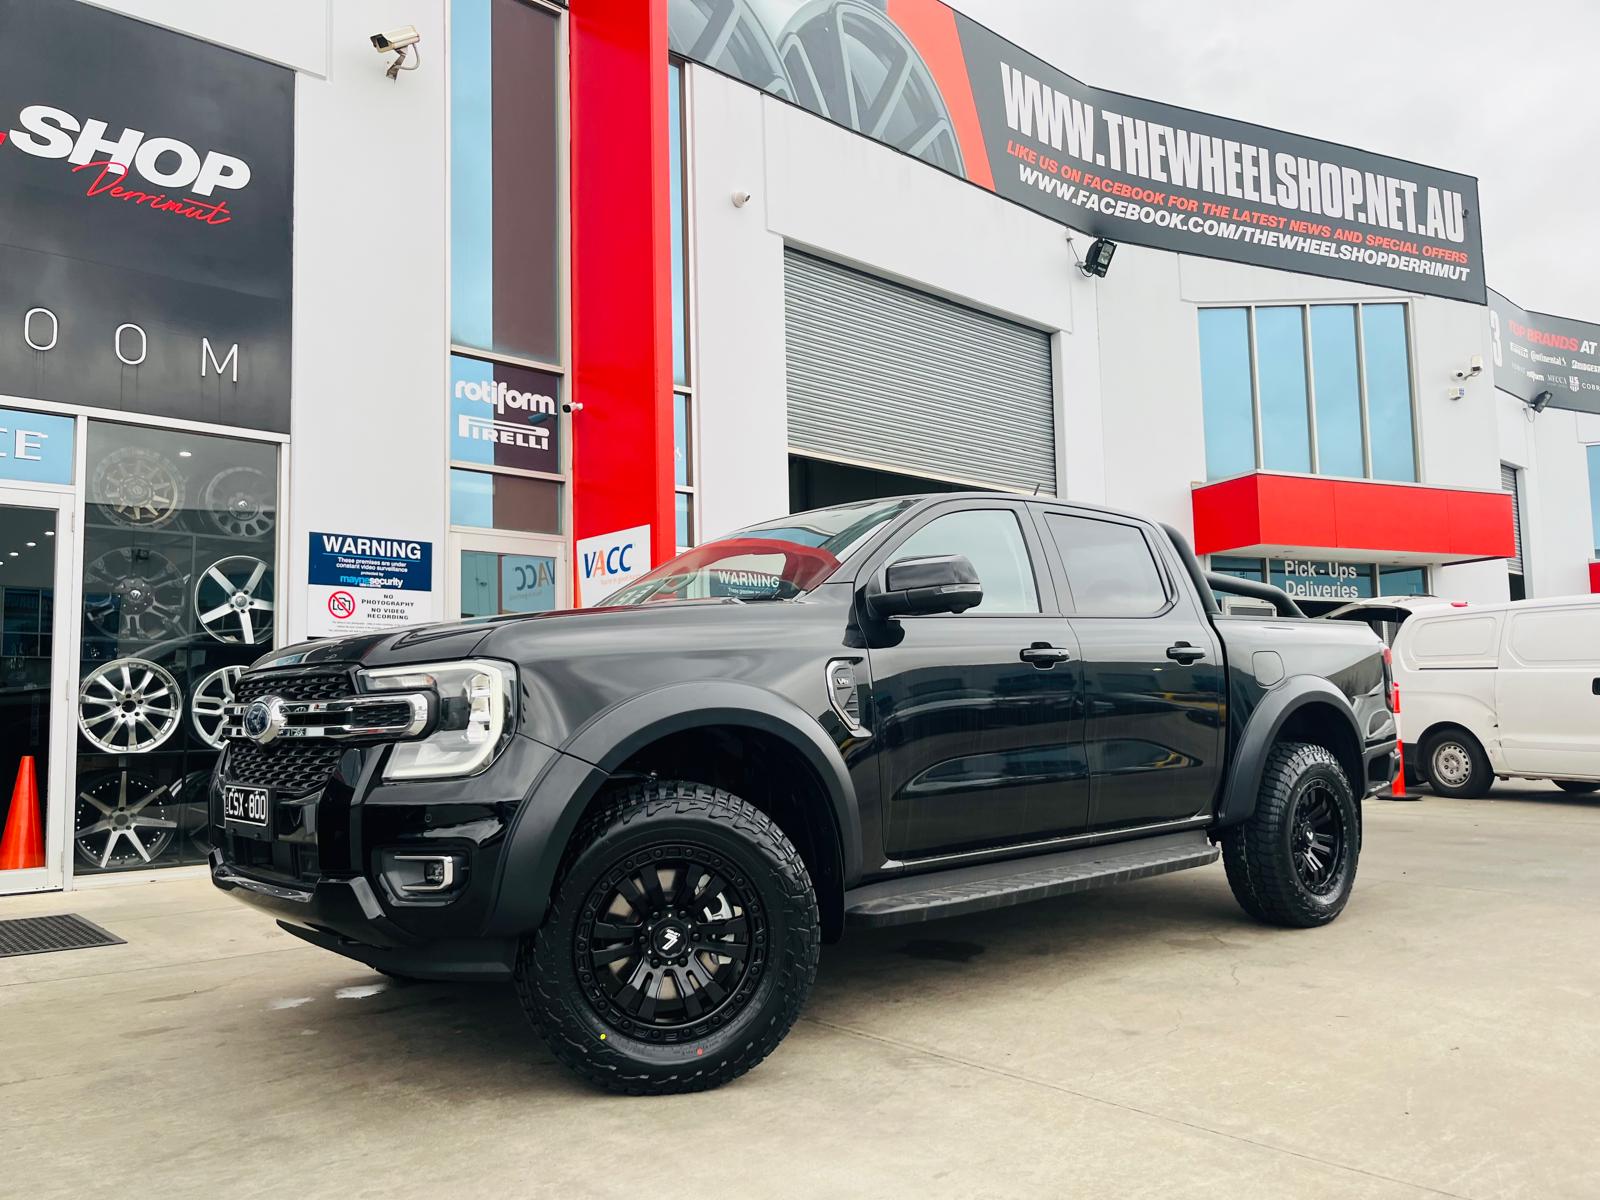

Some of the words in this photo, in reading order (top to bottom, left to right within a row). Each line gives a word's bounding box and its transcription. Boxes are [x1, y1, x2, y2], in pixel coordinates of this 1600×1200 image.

[9, 105, 251, 197] SHOP
[1000, 61, 1464, 243] WWW.THEWHEELSHOP.NET.AU
[72, 161, 231, 225] Derrimut
[1007, 140, 1037, 165] LIKE
[1039, 154, 1059, 174] US
[1061, 165, 1082, 184] ON
[1083, 174, 1165, 206] FACEBOOK
[1168, 195, 1198, 213] FOR
[1202, 202, 1230, 219] THE
[1233, 205, 1287, 229] LATEST
[1289, 220, 1332, 239] NEWS
[1334, 229, 1363, 244] AND
[1366, 235, 1419, 255] SPECIAL
[1422, 245, 1468, 264] OFFERS
[1019, 164, 1470, 282] WWW.FACEBOOK.COM/THEWHEELSHOPDERRIMUT
[1527, 329, 1579, 352] BRANDS
[1580, 340, 1598, 355] AT
[455, 380, 557, 415] rotiform
[458, 414, 550, 450] PIRELLI
[322, 535, 421, 560] WARNING
[356, 558, 381, 566] premises
[583, 543, 633, 578] VACC
[718, 570, 780, 588] WARNING
[1284, 560, 1317, 577] Pick
[1328, 561, 1357, 582] Ups
[361, 599, 415, 607] PHOTOGRAPHY
[1285, 580, 1359, 598] Deliveries
